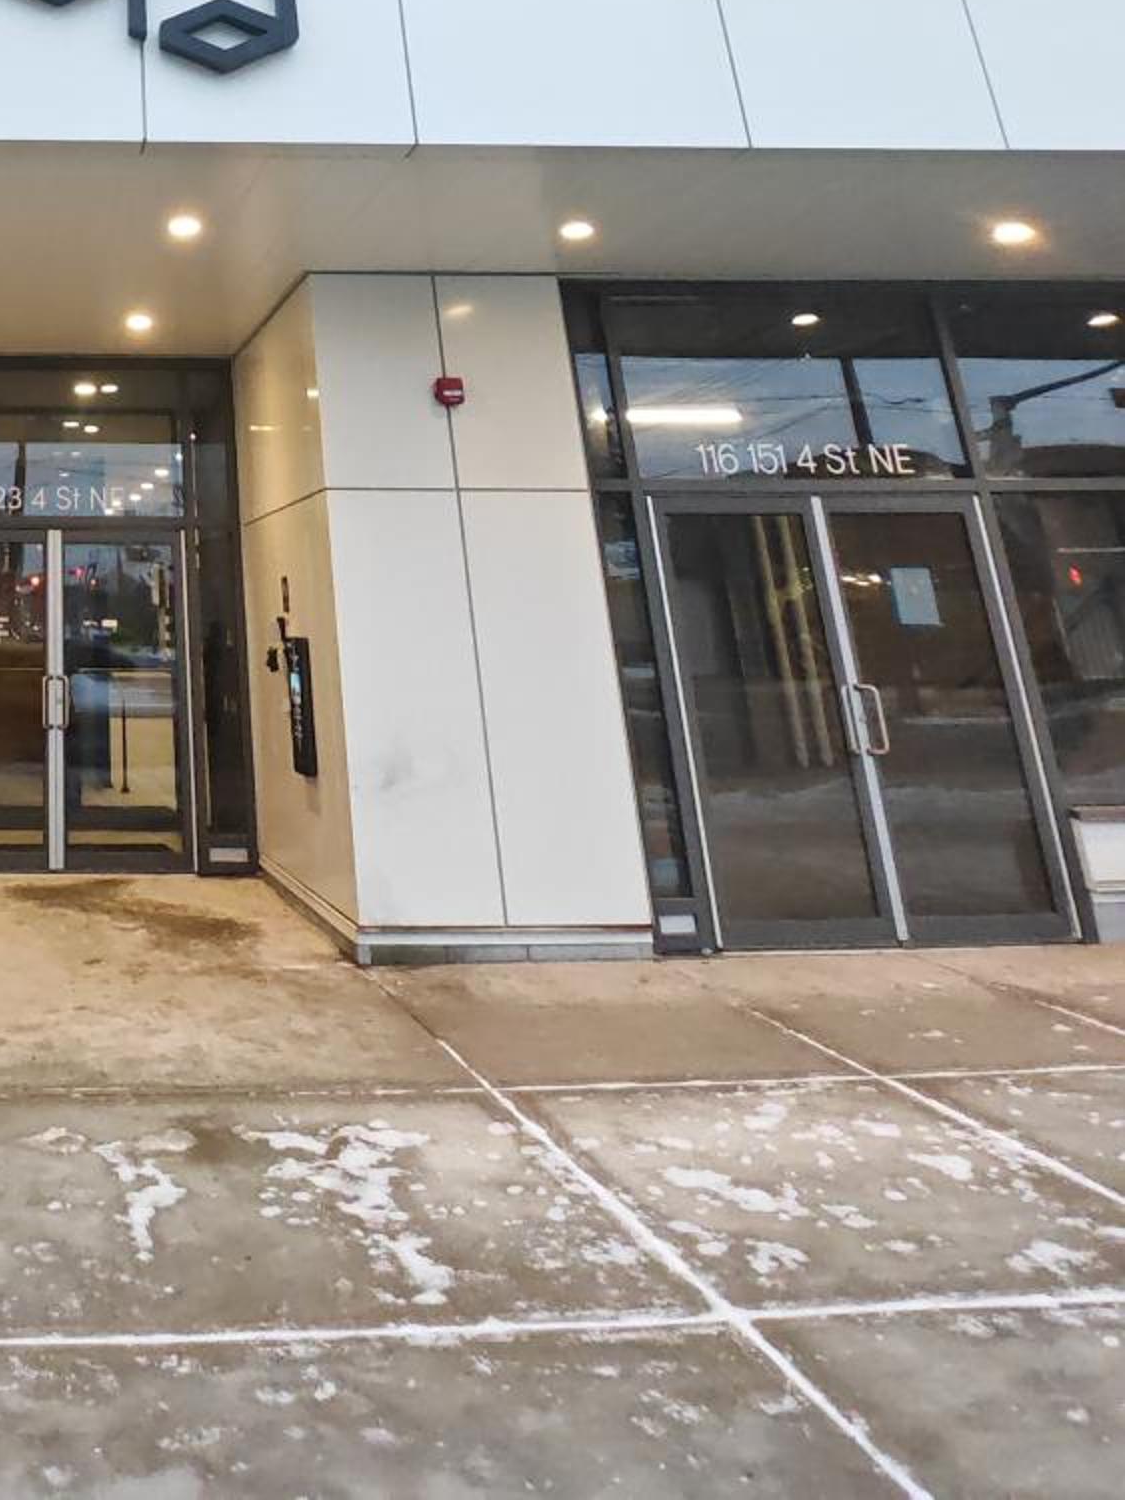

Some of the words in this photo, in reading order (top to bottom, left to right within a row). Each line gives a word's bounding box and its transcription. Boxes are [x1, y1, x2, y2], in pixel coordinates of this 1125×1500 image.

[696, 443, 740, 475] 116
[747, 443, 789, 475] 151
[796, 444, 818, 475] 4
[824, 443, 860, 475] St
[868, 443, 916, 474] NE
[30, 486, 48, 511] 4
[56, 485, 81, 511] St
[89, 485, 124, 512] NE
